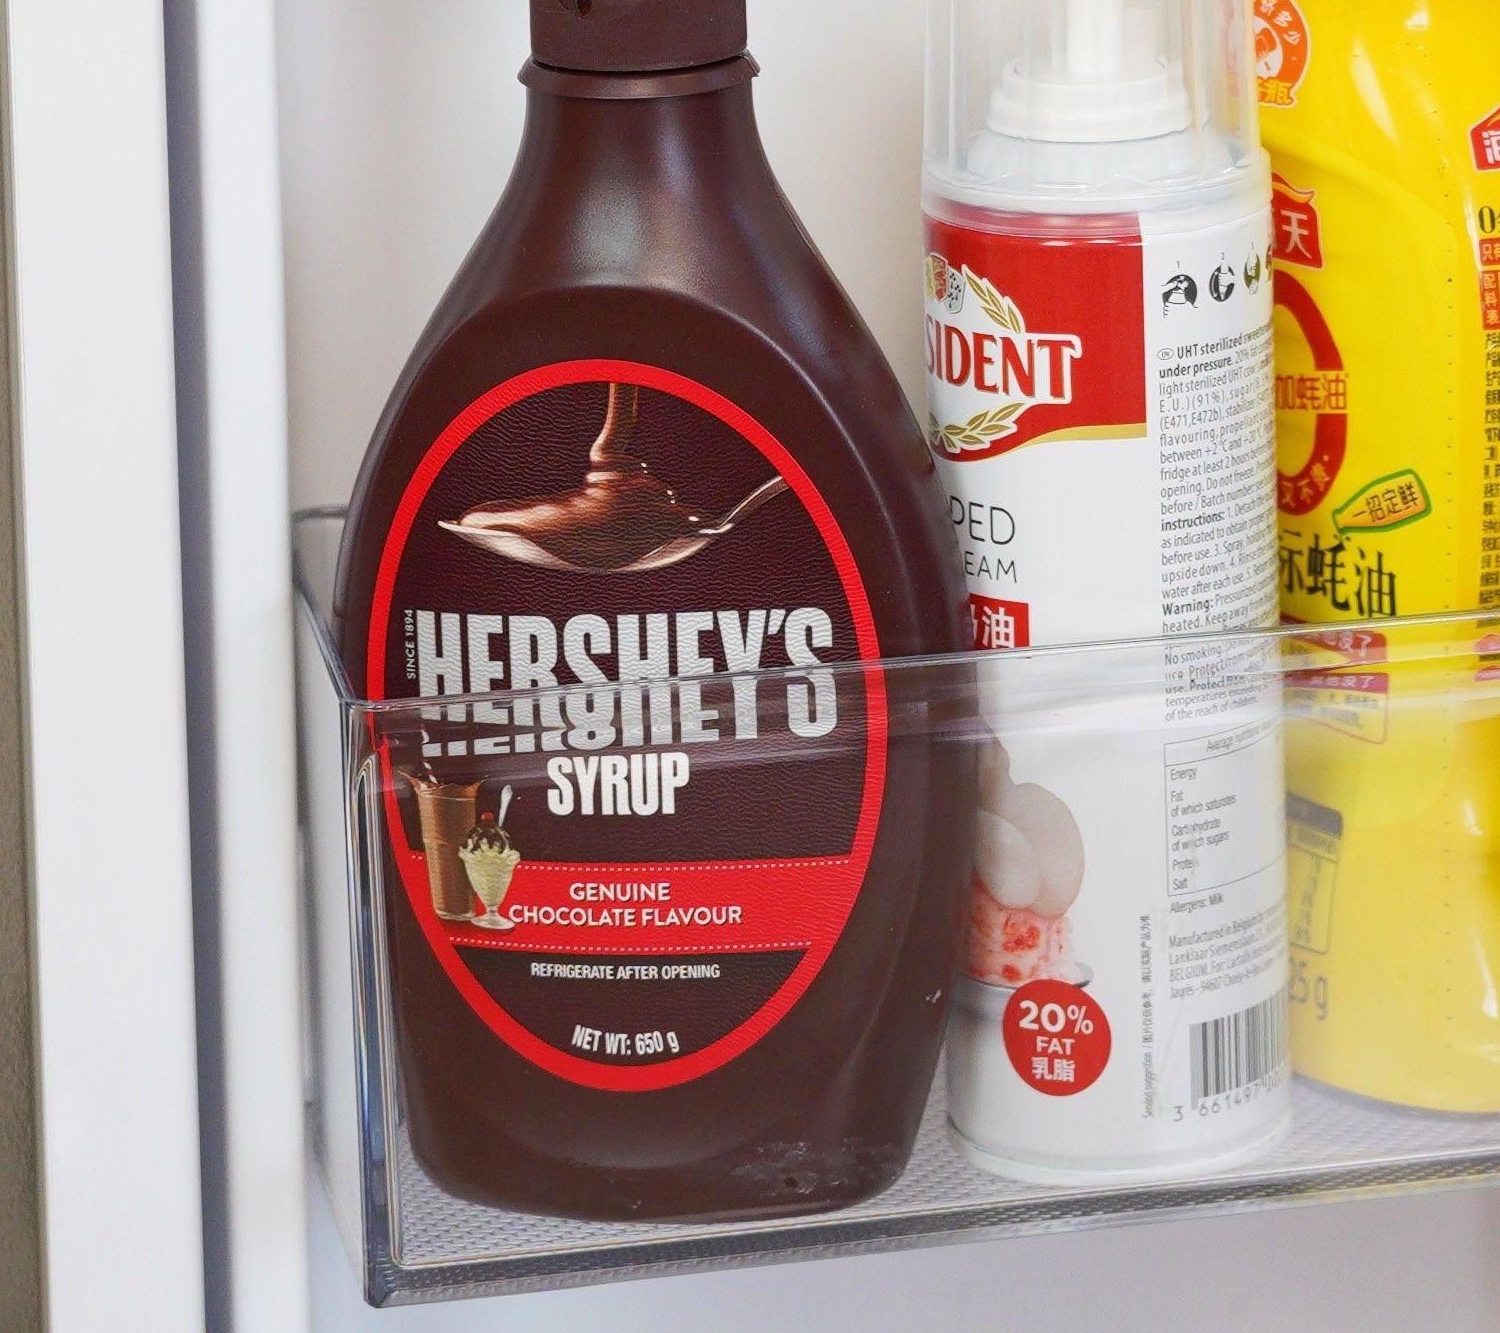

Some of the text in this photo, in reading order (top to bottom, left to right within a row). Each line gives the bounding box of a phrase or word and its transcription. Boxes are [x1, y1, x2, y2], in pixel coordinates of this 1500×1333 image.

[1280, 209, 1312, 259] 天
[1177, 332, 1243, 359] UHT sterilized
[1159, 364, 1192, 379] under
[1159, 381, 1184, 398] light
[1186, 374, 1227, 393] sterilized
[1160, 448, 1202, 464] between
[1160, 465, 1191, 482] fridge
[1192, 464, 1201, 477] at
[1203, 458, 1224, 474] least
[1160, 472, 1233, 500] opening. Do not
[1161, 492, 1226, 515] before Batch
[1353, 481, 1419, 523] 一招定鲜
[1161, 511, 1226, 531] instructions:
[1161, 537, 1172, 549] as
[1174, 528, 1215, 547] indicated
[1217, 526, 1225, 539] to
[1161, 549, 1193, 566] before
[1194, 548, 1211, 561] use.
[1161, 560, 1227, 586] upside down.
[1161, 584, 1189, 600] water
[1190, 579, 1212, 595] after
[1212, 574, 1231, 591] each
[1161, 597, 1214, 617] Warning:
[970, 603, 1016, 649] 油
[1161, 616, 1203, 634] heated.
[1204, 609, 1228, 627] Keep
[404, 609, 415, 680] SINCE 1894
[1163, 653, 1179, 666] No
[415, 606, 840, 758] HERSHEY'S
[1165, 689, 1228, 707] temperatures
[1164, 708, 1176, 722] of
[1177, 707, 1193, 721] the
[1194, 702, 1219, 718] reach
[547, 752, 690, 817] SYRUP
[1170, 767, 1197, 781] Energy
[1171, 790, 1184, 802] Fat
[1171, 805, 1180, 817] of
[1180, 801, 1203, 816] which
[1171, 840, 1180, 852] of
[1206, 831, 1230, 846] sugars
[569, 882, 671, 903] GENUINE
[1172, 877, 1188, 891] Salt
[508, 904, 743, 927] CHOCOLATE FLAVOUR
[1169, 925, 1224, 948] Manufactured
[530, 961, 721, 981] REFRIGERATE AFTER OPENING
[1017, 999, 1094, 1036] 20%
[572, 1024, 681, 1057] NET WT: 650 g
[1036, 1036, 1075, 1057] FAT
[1031, 1058, 1077, 1083] 乳脂
[1172, 1104, 1184, 1123] 3
